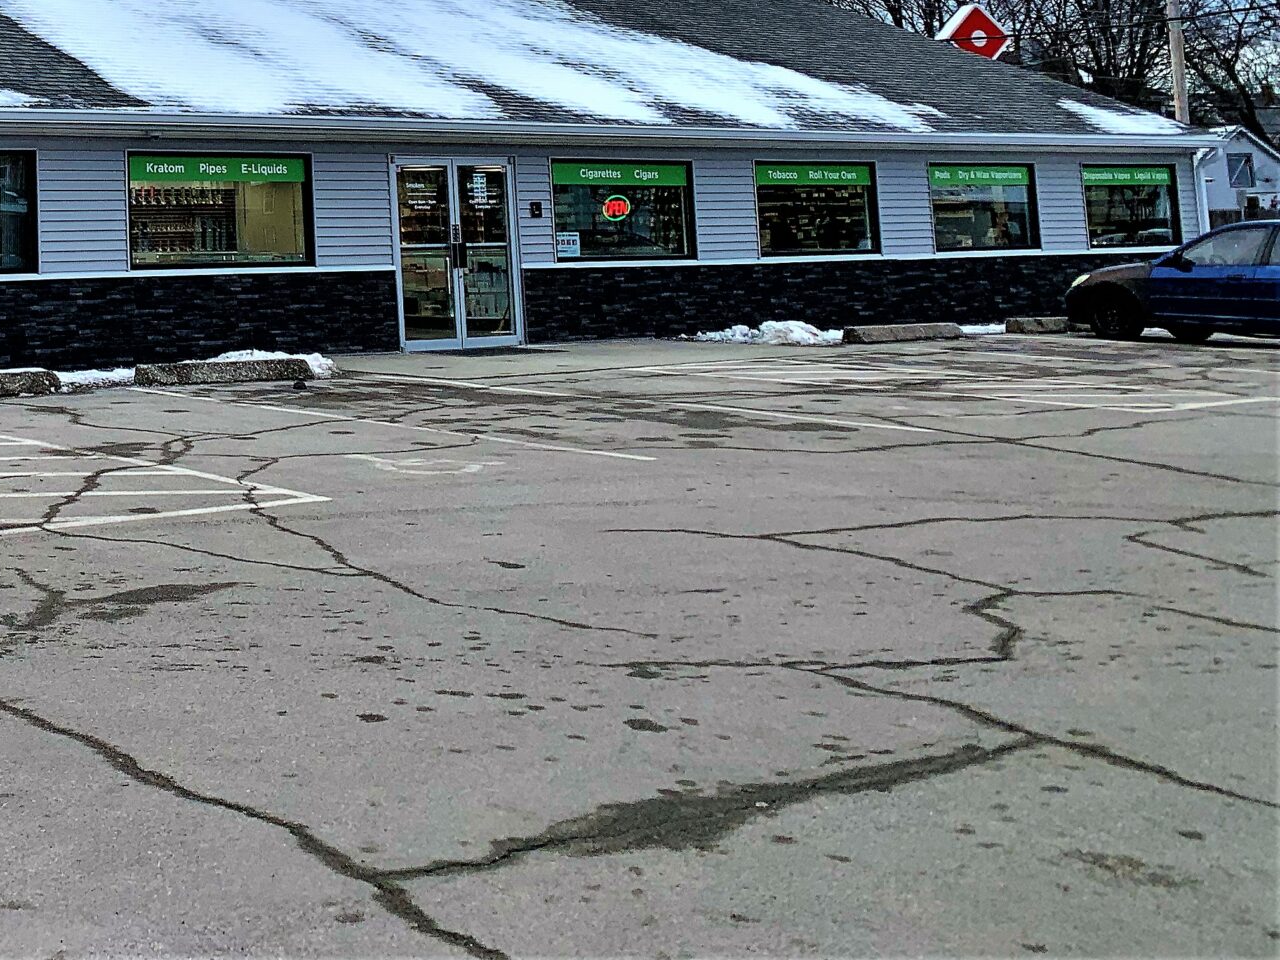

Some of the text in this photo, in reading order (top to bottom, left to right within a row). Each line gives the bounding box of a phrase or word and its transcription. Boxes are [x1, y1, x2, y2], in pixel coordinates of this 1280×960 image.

[146, 163, 288, 175] Kratom Pipes E-Liquids
[580, 169, 659, 180] Cigarettes Cigars
[768, 171, 857, 179] Tobacco Roll Your Own
[605, 200, 628, 216] OPEN
